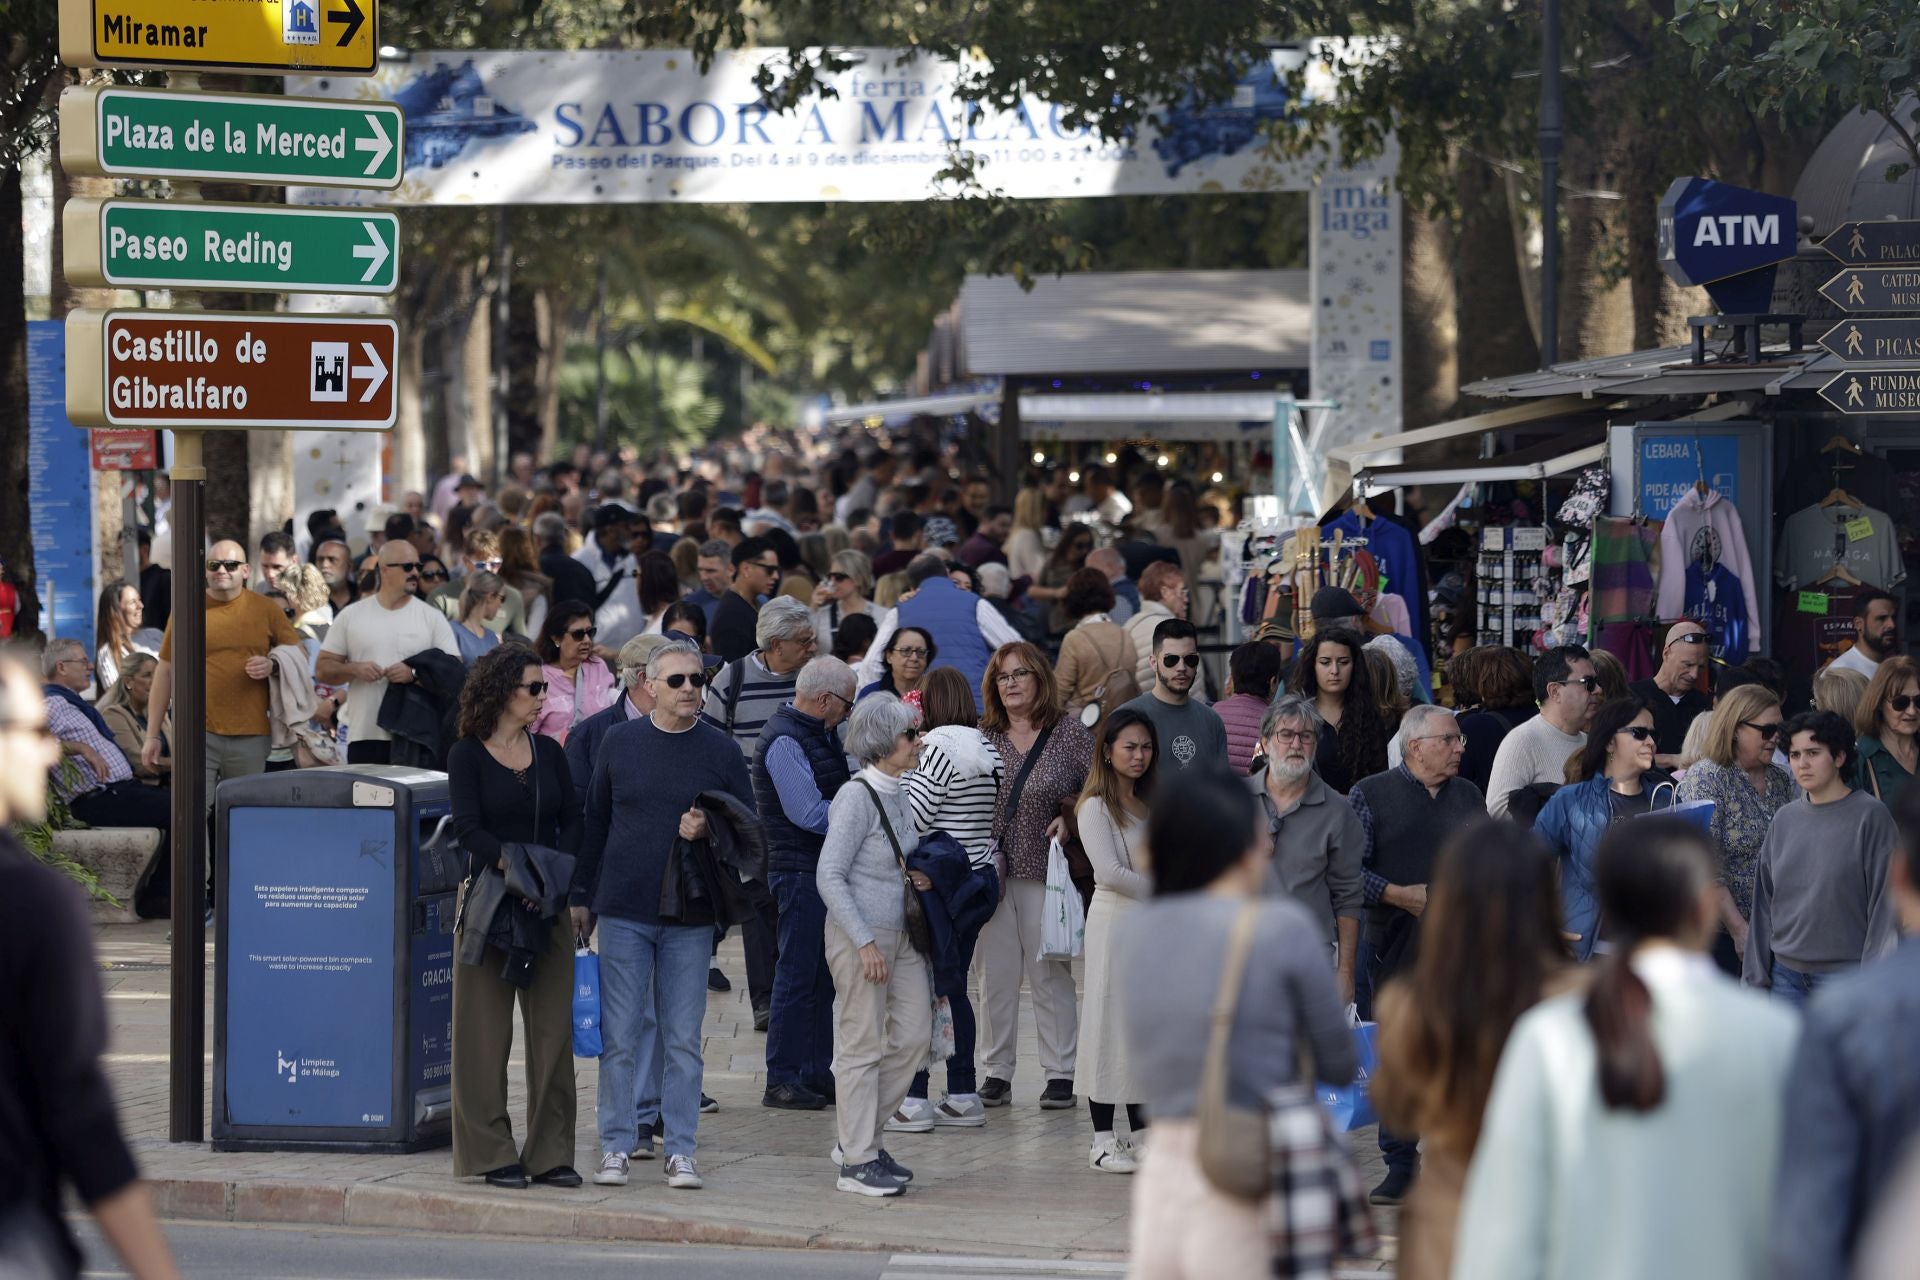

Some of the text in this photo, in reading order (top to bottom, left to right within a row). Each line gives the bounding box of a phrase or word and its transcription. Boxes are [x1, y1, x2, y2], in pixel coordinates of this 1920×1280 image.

[104, 14, 208, 48] Miramar
[853, 70, 925, 97] feria
[554, 84, 1138, 147] SABOR A MÁLAG
[107, 114, 346, 159] Plaza de la Merced
[552, 153, 611, 169] Paseo
[617, 153, 646, 169] del
[731, 152, 762, 167] Del
[807, 152, 818, 166] 9
[825, 152, 848, 166] de
[1321, 203, 1390, 240] laga
[1693, 214, 1779, 247] ATM
[110, 226, 292, 272] Paseo Reding
[1882, 273, 1920, 288] CATED
[112, 328, 267, 364] Castillo de
[1875, 338, 1920, 356] PICAS
[112, 376, 248, 410] Gibralfaro
[1645, 444, 1690, 459] LEBARA
[1645, 484, 1670, 496] PIDE
[1654, 498, 1669, 511] TU
[1823, 622, 1857, 631] ESPAÑ
[254, 885, 369, 895] Esta papelera inteligente compacta
[323, 894, 348, 902] energía
[323, 902, 358, 910] capacidad
[248, 954, 262, 962] This
[283, 955, 328, 963] solar-powered
[340, 957, 373, 965] compacts
[297, 963, 324, 971] increase
[324, 964, 352, 973] capacity
[301, 1058, 335, 1067] Limpieza
[301, 1067, 340, 1078] de Málaga
